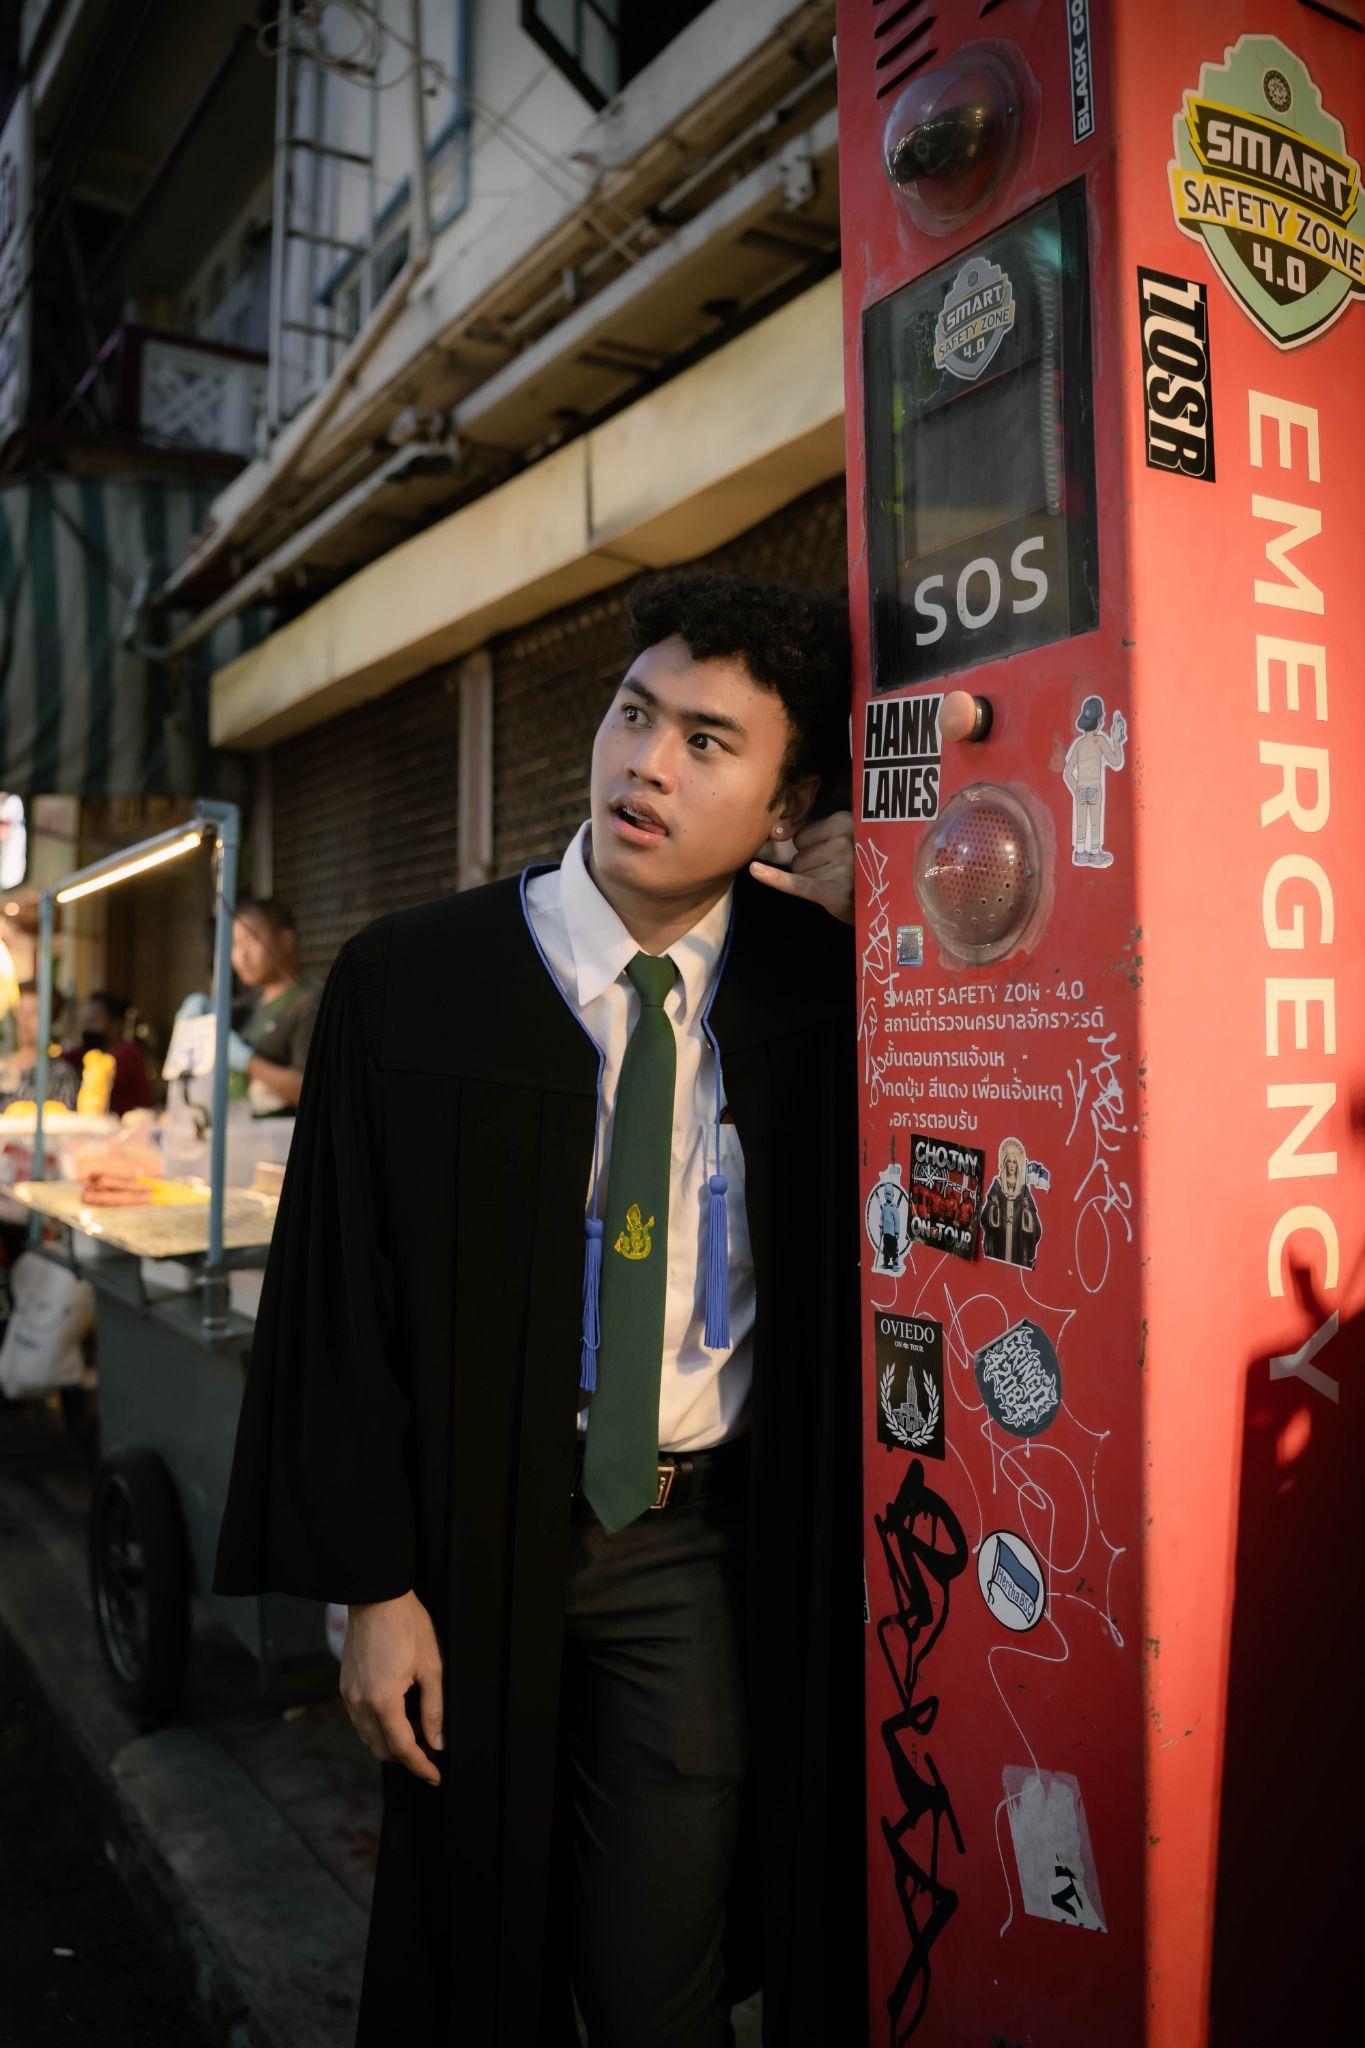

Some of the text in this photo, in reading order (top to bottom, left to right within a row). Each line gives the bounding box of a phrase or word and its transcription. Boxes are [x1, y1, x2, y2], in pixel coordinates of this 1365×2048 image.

[1074, 41, 1091, 136] BLACK
[1206, 119, 1347, 211] SMART
[1184, 179, 1364, 276] SAFETY ZONE
[1252, 241, 1307, 294] 4.0
[939, 308, 1010, 357] SAFETY ZONE
[946, 285, 1002, 332] SMART
[963, 337, 985, 359] 4.0
[914, 536, 1048, 646] SOS
[865, 697, 940, 758] HANK
[862, 766, 939, 819] LANES
[1248, 388, 1340, 1405] EMERGENCY
[883, 980, 1084, 1008] SMART SAFETY ZON 4.0
[928, 1075, 968, 1099] สีแดง
[888, 1109, 978, 1131] อการตอบรับ
[914, 1141, 978, 1175] CHOJNY
[911, 1216, 972, 1249] ON TOUR
[880, 1318, 935, 1344] OVIEDO
[909, 1343, 924, 1353] TOUR
